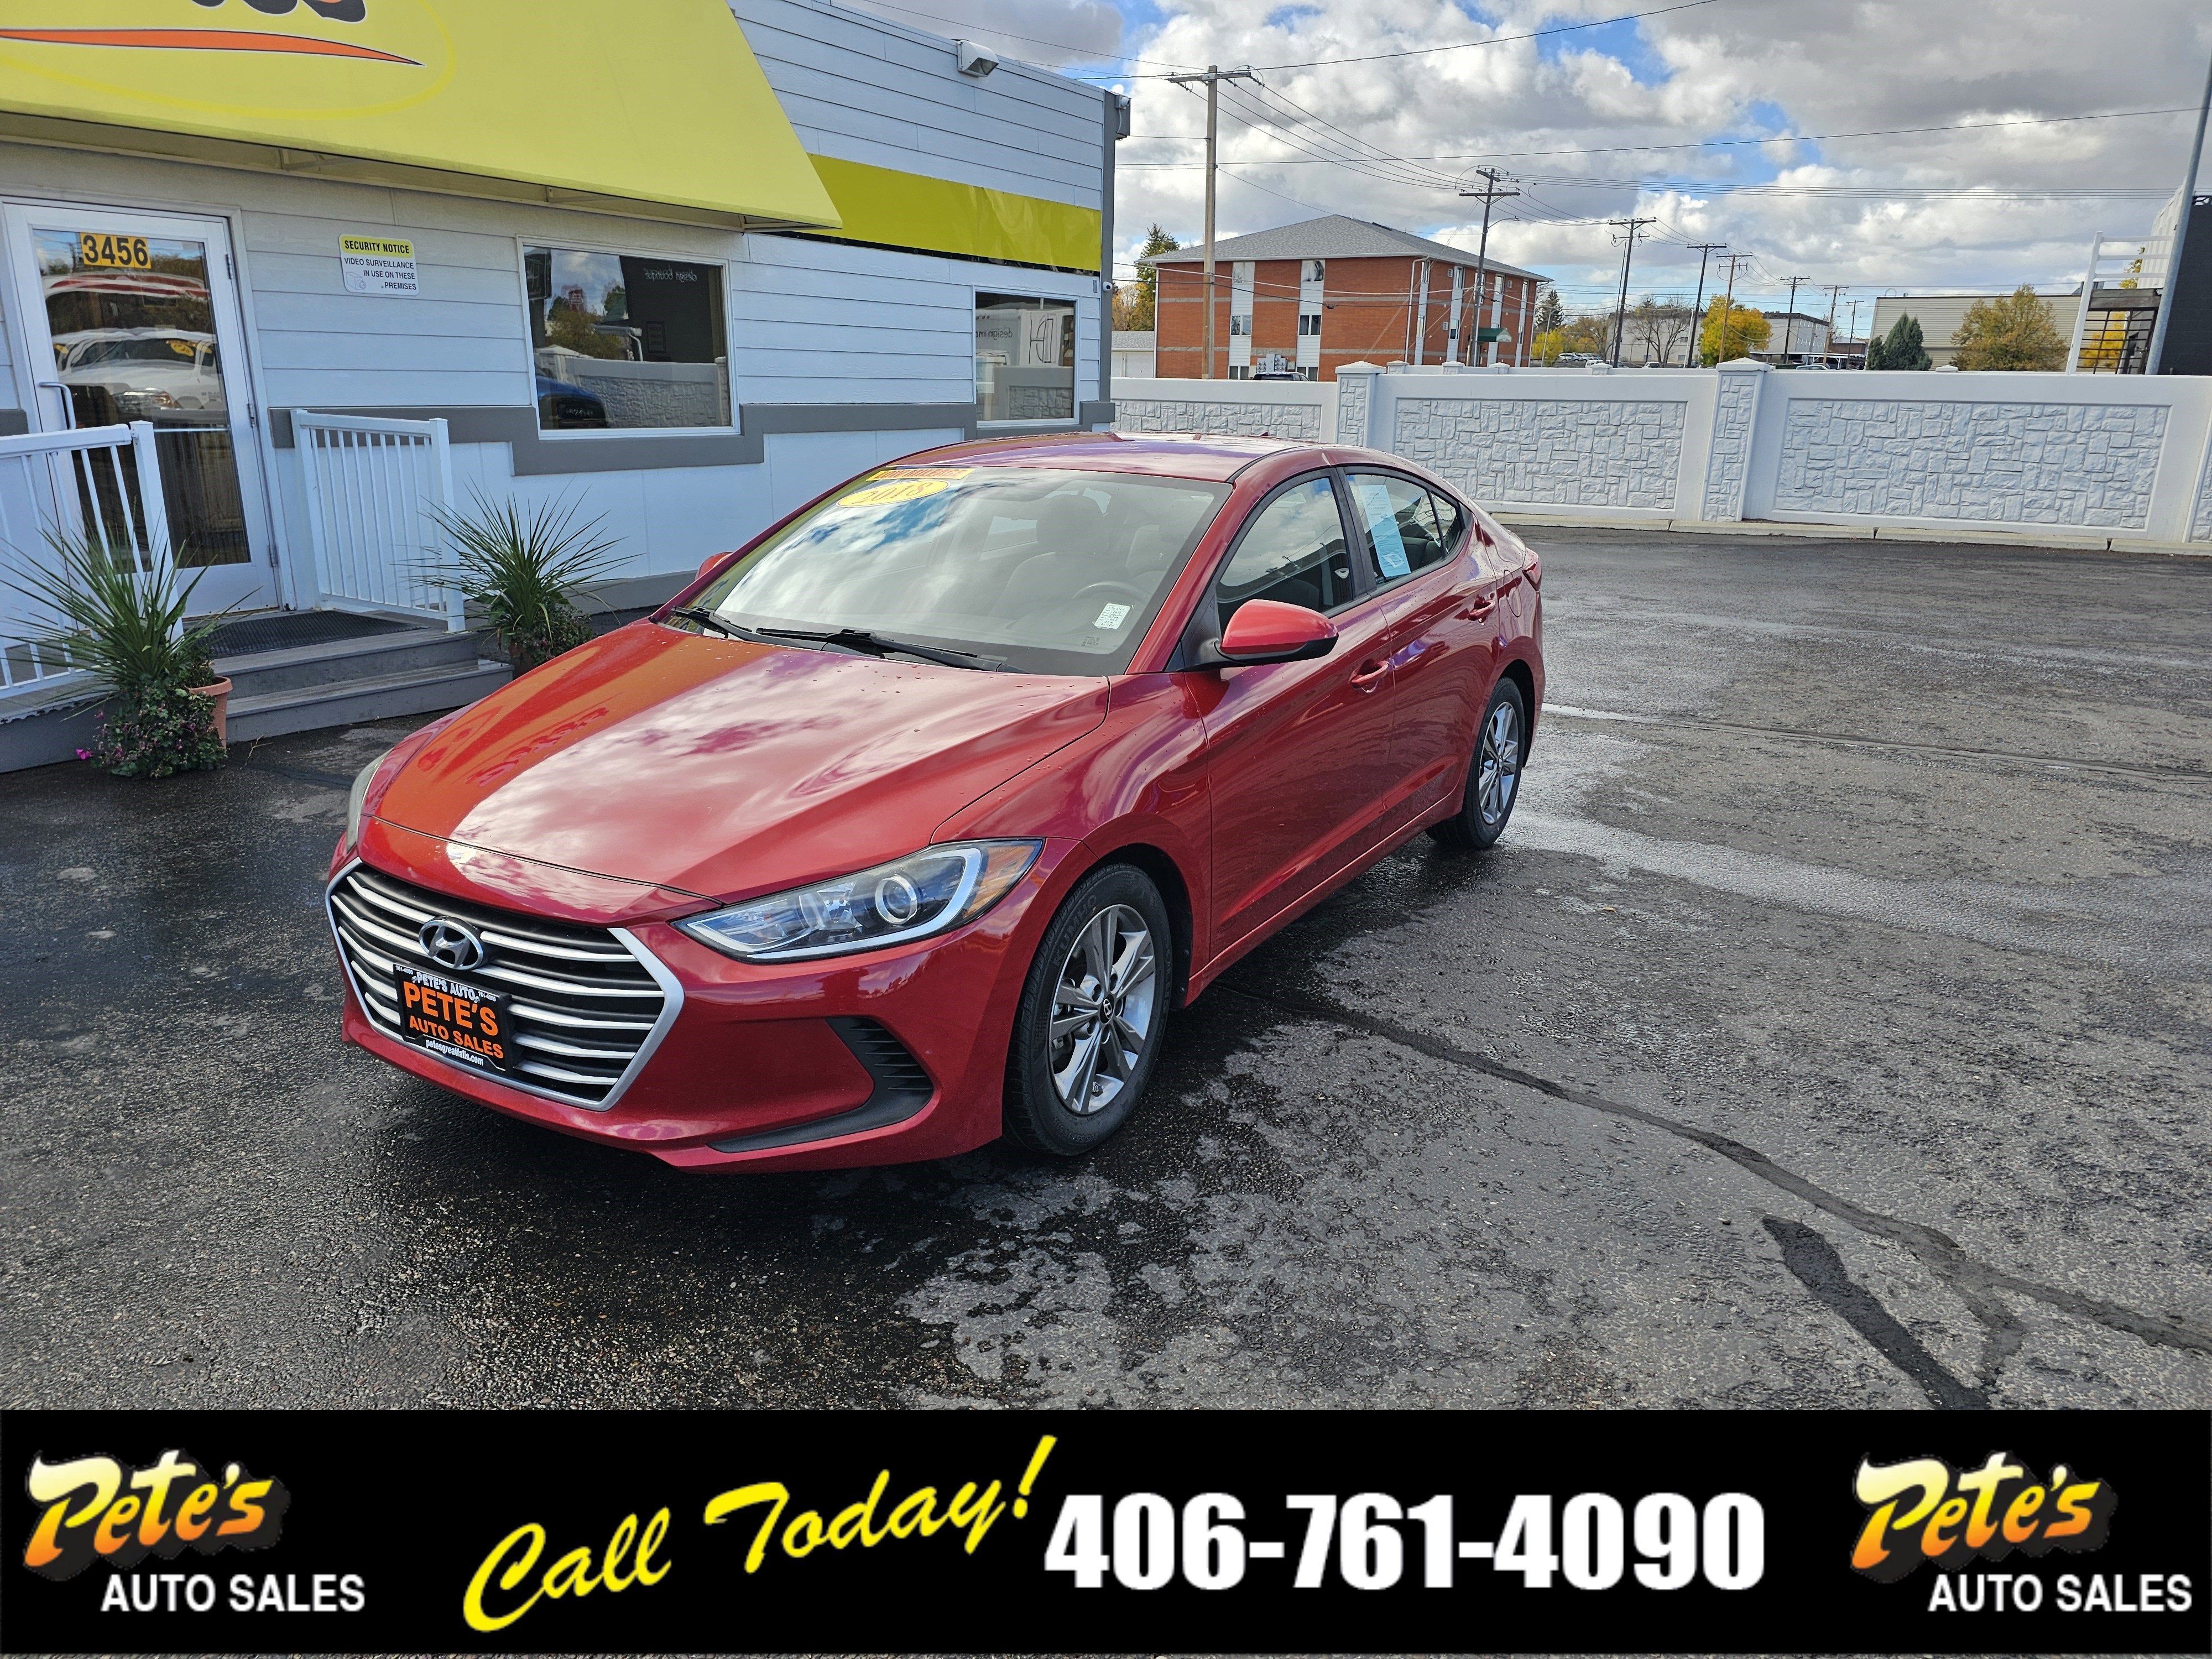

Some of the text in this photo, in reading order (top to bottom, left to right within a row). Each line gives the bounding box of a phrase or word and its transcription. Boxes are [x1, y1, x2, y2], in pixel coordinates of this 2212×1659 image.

[83, 235, 148, 266] 3456
[345, 240, 410, 254] SECURITY NOTICE
[366, 259, 414, 269] SURVEILLANCE
[384, 282, 416, 290] PREMISES
[852, 482, 933, 504] 2018
[1053, 894, 1097, 967] KUMHO
[416, 971, 476, 1001] PETE'S AUTO
[403, 981, 498, 1036] PETE'S
[410, 1015, 504, 1058] AUTO SALES
[426, 1039, 484, 1066] petesgreatfalls.com
